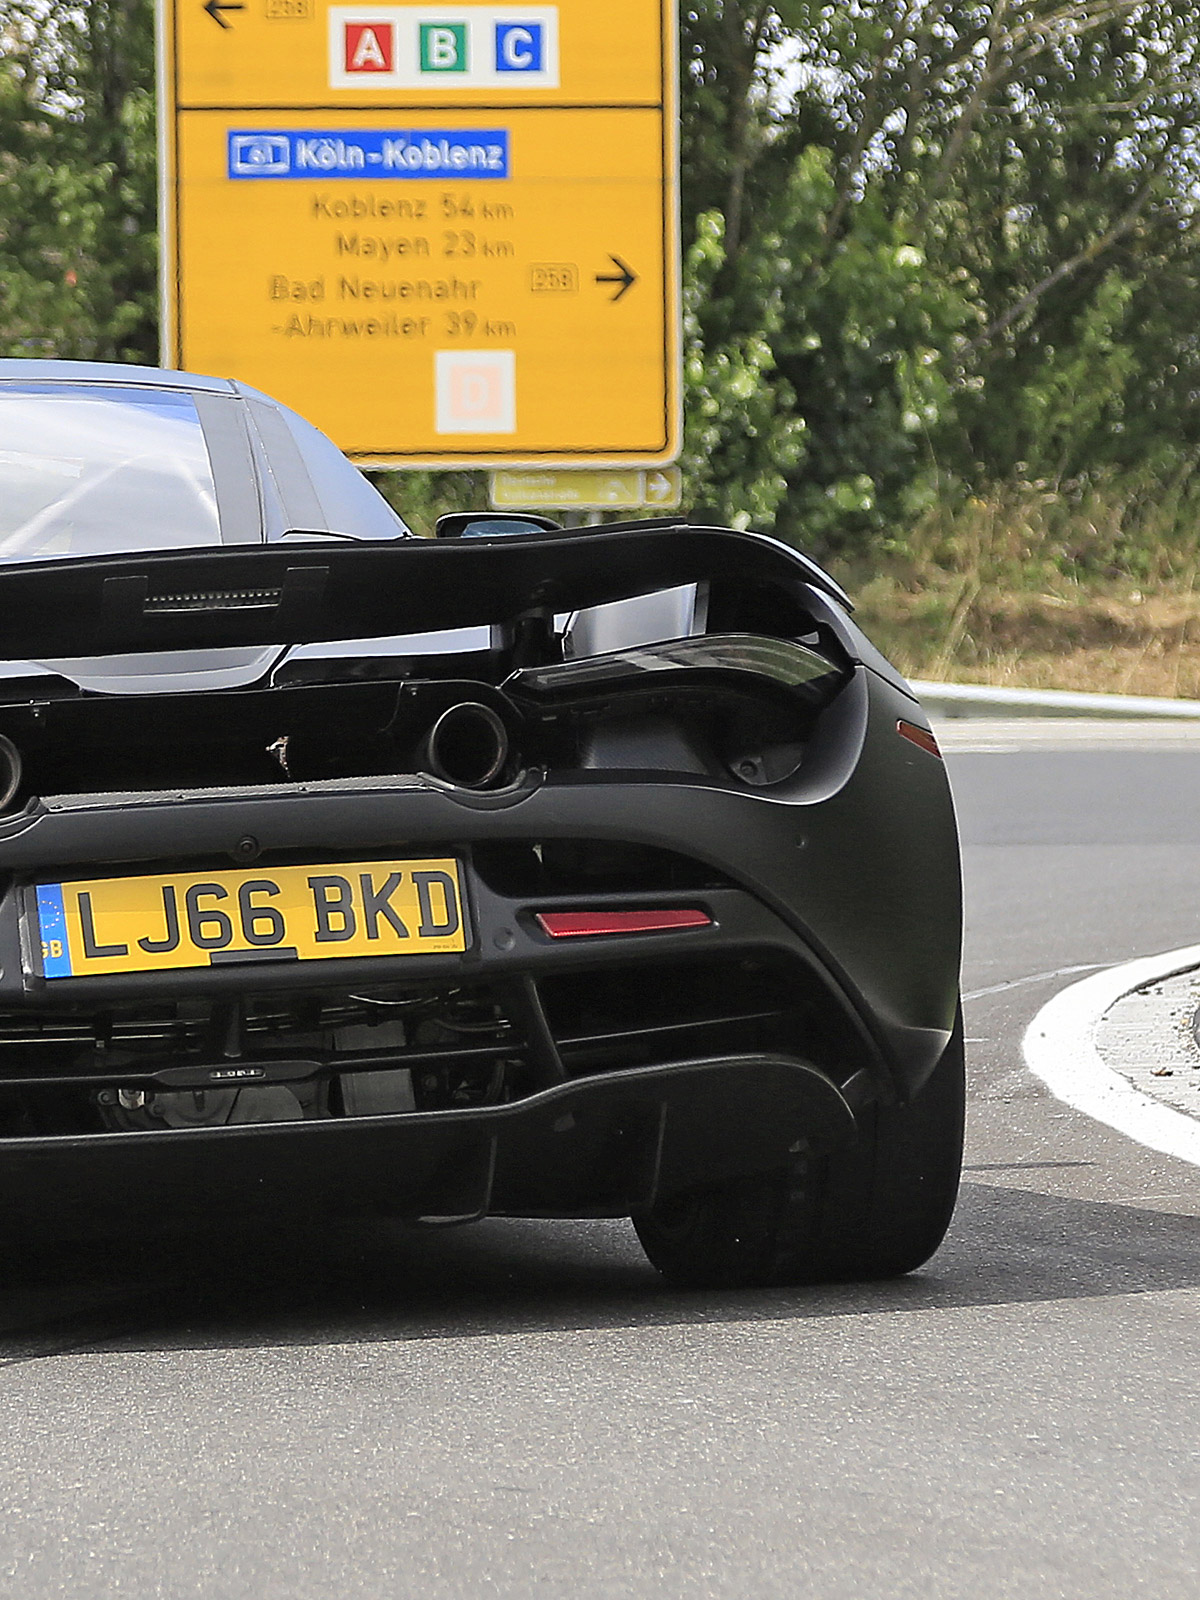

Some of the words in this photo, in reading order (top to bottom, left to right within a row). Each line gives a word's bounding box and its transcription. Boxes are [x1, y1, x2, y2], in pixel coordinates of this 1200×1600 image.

[352, 27, 386, 67] A
[428, 28, 458, 67] B
[502, 28, 534, 67] C
[296, 137, 505, 170] Köln-Koblenz
[311, 192, 428, 219] Koblenz
[442, 192, 475, 219] 54
[482, 202, 515, 219] km
[336, 230, 431, 262] Mayen
[443, 229, 477, 256] 23
[482, 237, 515, 256] km
[271, 274, 325, 301] Bad
[340, 275, 482, 301] Neuenahr
[271, 311, 432, 338] -Ahrweiler
[447, 309, 478, 337] 39
[484, 319, 517, 338] km
[462, 373, 490, 412] D
[78, 879, 286, 959] LJ66
[307, 871, 460, 943] BKD
